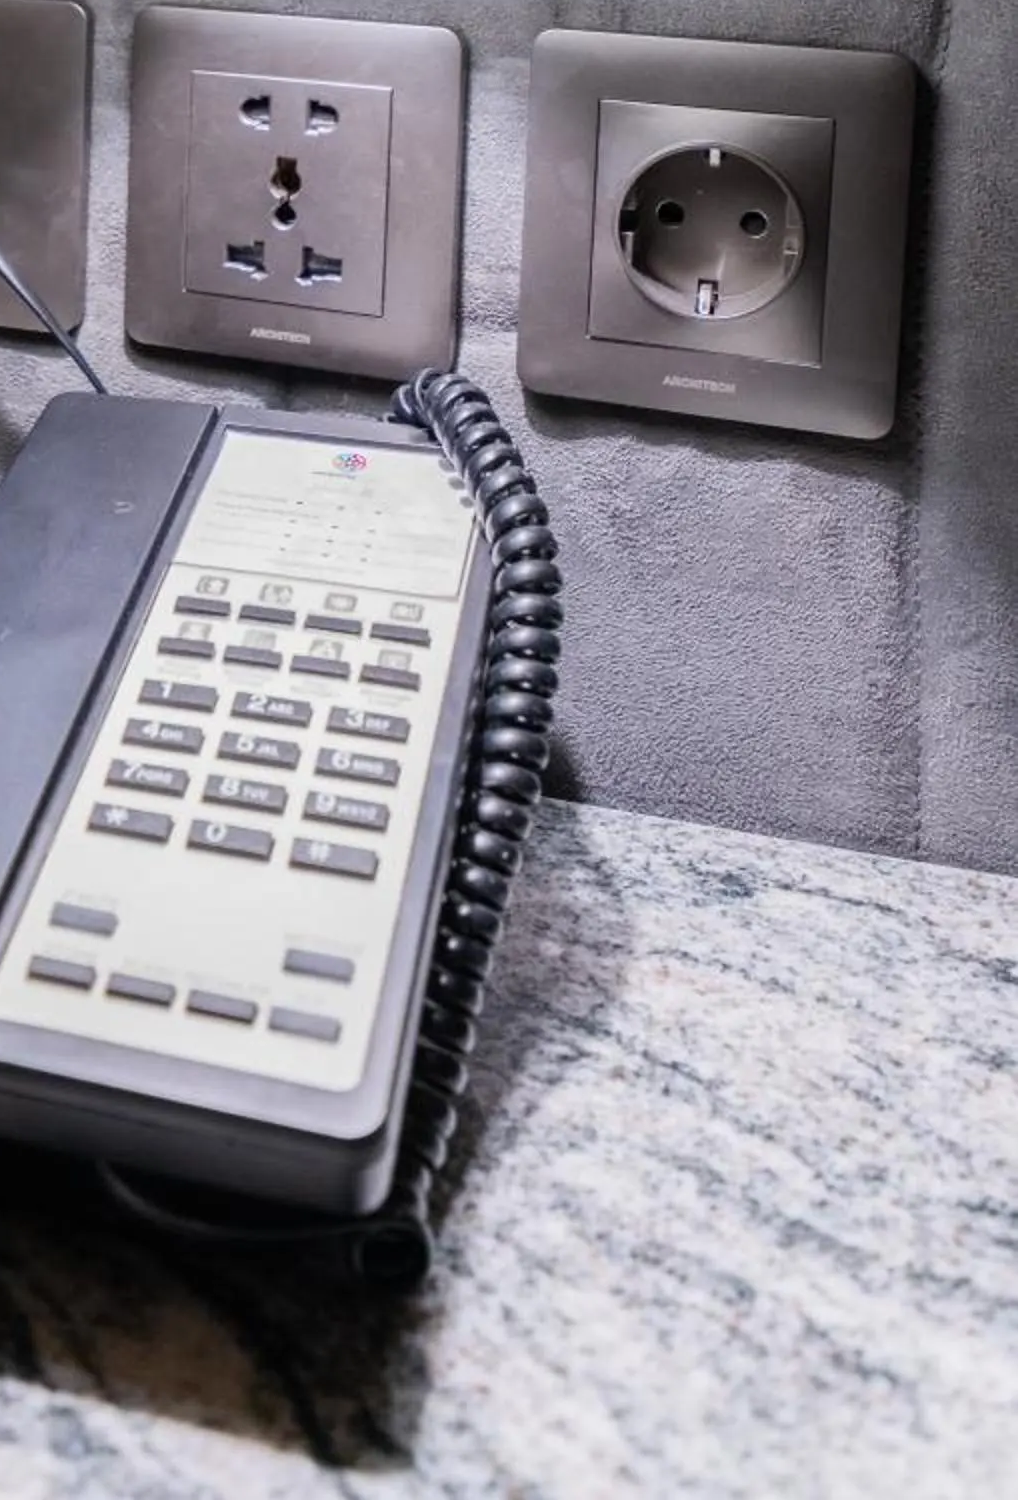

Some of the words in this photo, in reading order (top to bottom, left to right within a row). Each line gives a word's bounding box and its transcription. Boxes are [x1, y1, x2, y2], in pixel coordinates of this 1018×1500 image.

[160, 681, 174, 699] 1
[246, 694, 268, 713] 2
[345, 709, 365, 728] 3
[141, 721, 161, 738] 4
[331, 751, 351, 770] 6
[205, 822, 228, 843] 0
